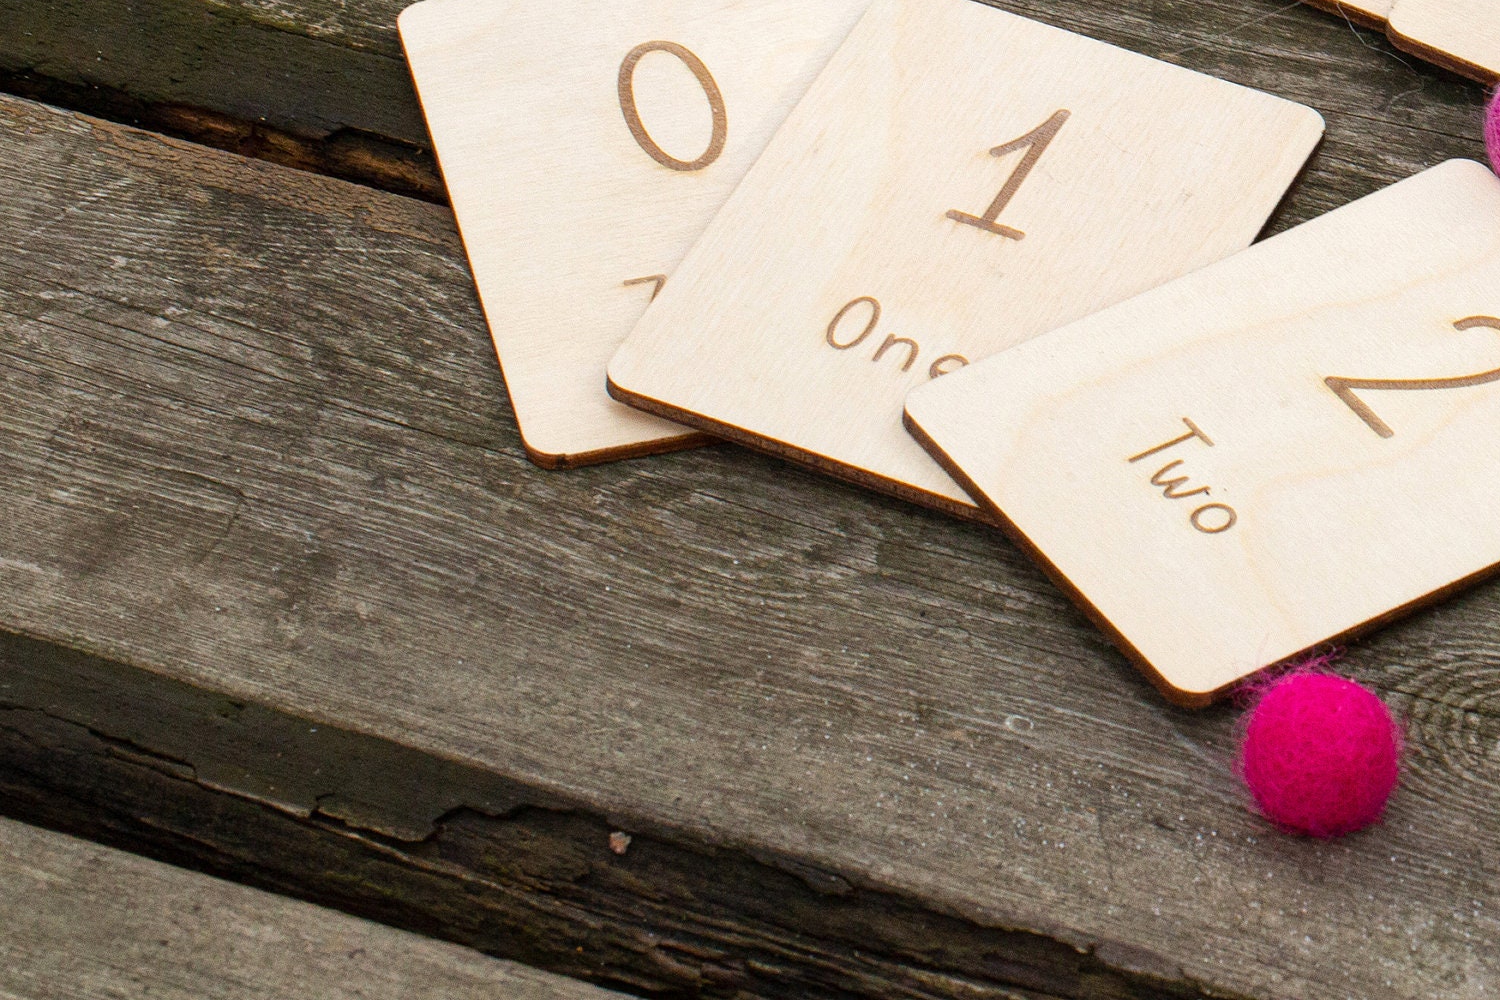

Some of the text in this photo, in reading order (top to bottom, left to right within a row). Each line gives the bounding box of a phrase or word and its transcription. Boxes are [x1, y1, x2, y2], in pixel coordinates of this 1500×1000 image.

[617, 39, 729, 176] 0
[941, 108, 1072, 242] 1
[1125, 416, 1238, 535] Two
